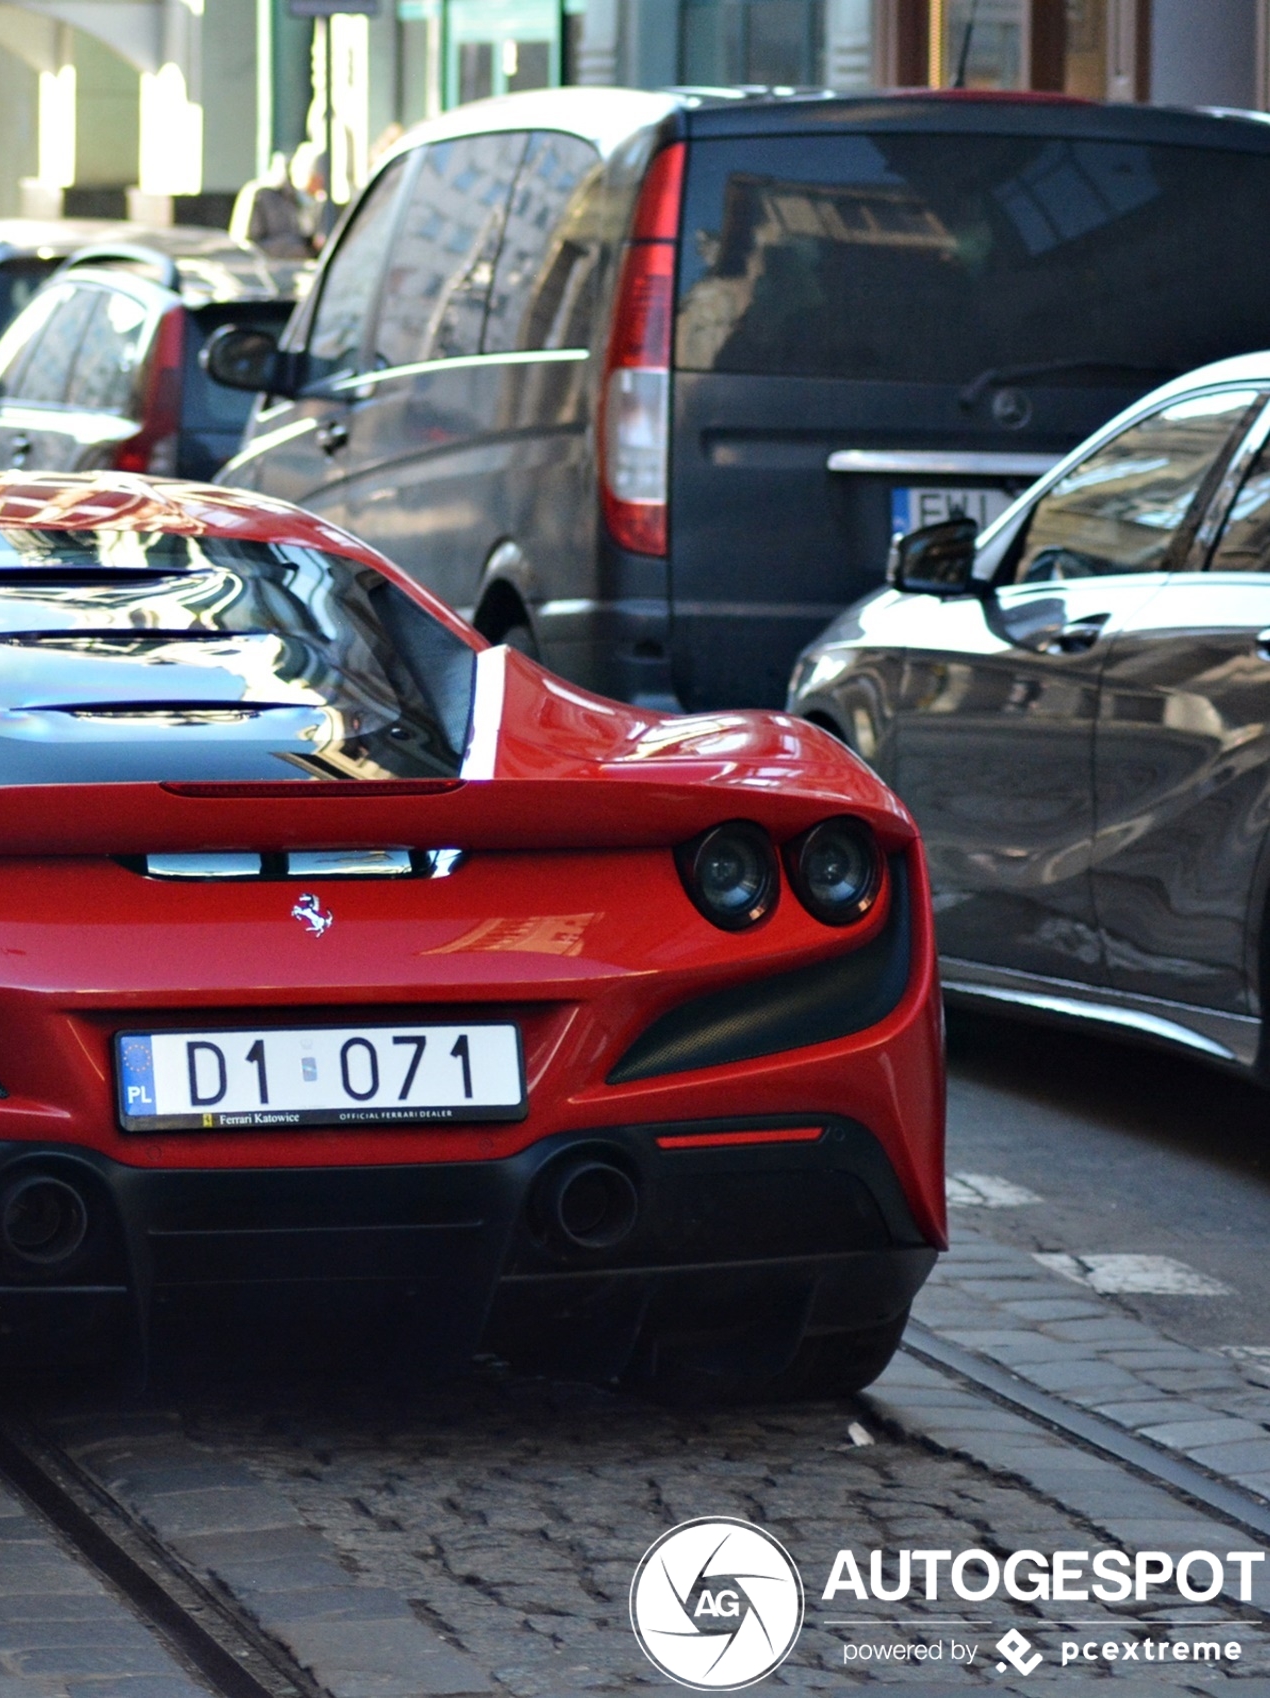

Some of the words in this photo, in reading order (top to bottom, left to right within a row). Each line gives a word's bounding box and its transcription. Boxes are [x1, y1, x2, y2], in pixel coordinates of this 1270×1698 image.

[186, 1039, 269, 1106] D1
[340, 1034, 473, 1102] 071
[127, 1085, 152, 1104] PL
[219, 1114, 253, 1125] Ferrari
[254, 1112, 300, 1124] Katowice
[339, 1112, 380, 1121] OFFICIAL
[381, 1111, 418, 1119] FERRARI
[419, 1109, 453, 1118] DEALER
